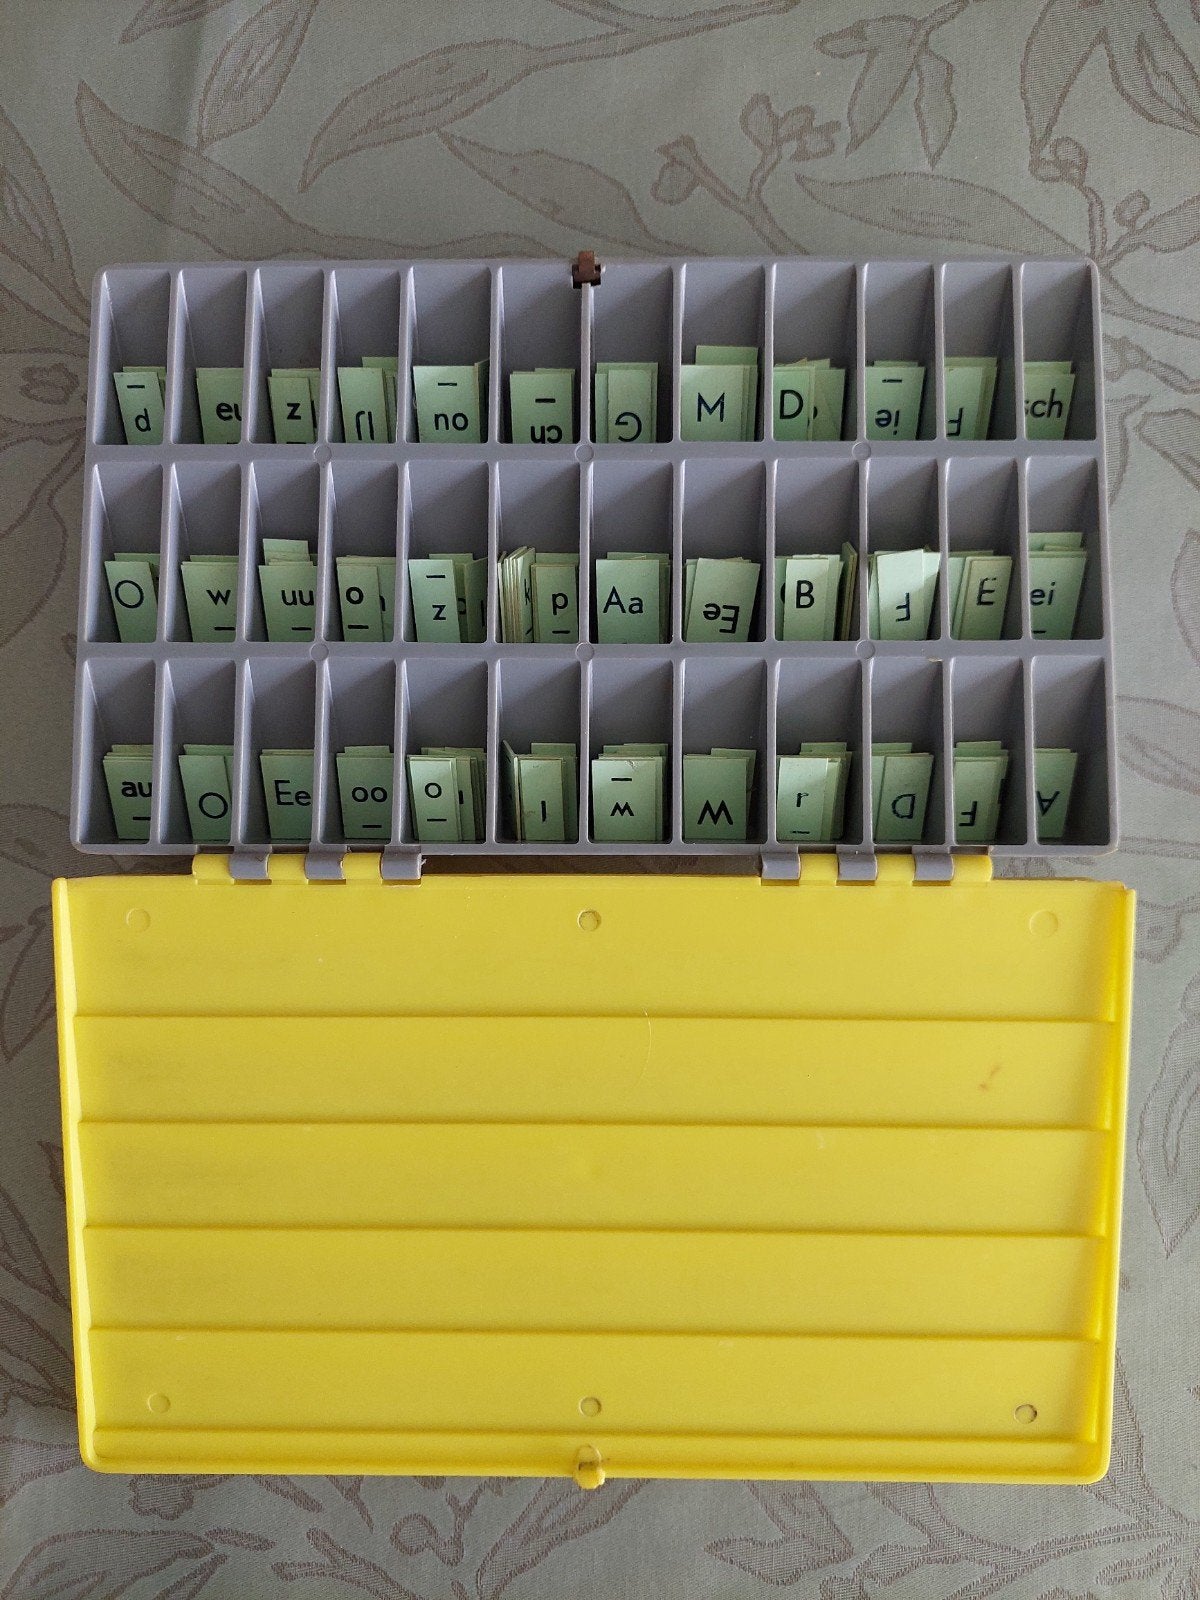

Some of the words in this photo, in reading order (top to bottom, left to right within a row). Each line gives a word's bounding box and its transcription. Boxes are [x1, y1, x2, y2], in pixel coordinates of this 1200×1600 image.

[697, 393, 725, 422] M
[780, 390, 803, 419] D
[434, 413, 468, 431] ou
[615, 412, 642, 442] G
[875, 410, 899, 435] ie
[281, 590, 314, 606] uu
[552, 593, 568, 615] p
[603, 586, 643, 614] Aa
[796, 580, 814, 608] B
[976, 578, 996, 606] E
[1031, 582, 1055, 606] ei
[703, 603, 740, 634] Ee
[896, 593, 910, 622] F
[121, 781, 152, 797] au
[274, 780, 311, 806] Ee
[352, 787, 387, 802] oo
[892, 794, 916, 819] D
[959, 801, 978, 827] F
[1037, 791, 1060, 816] A
